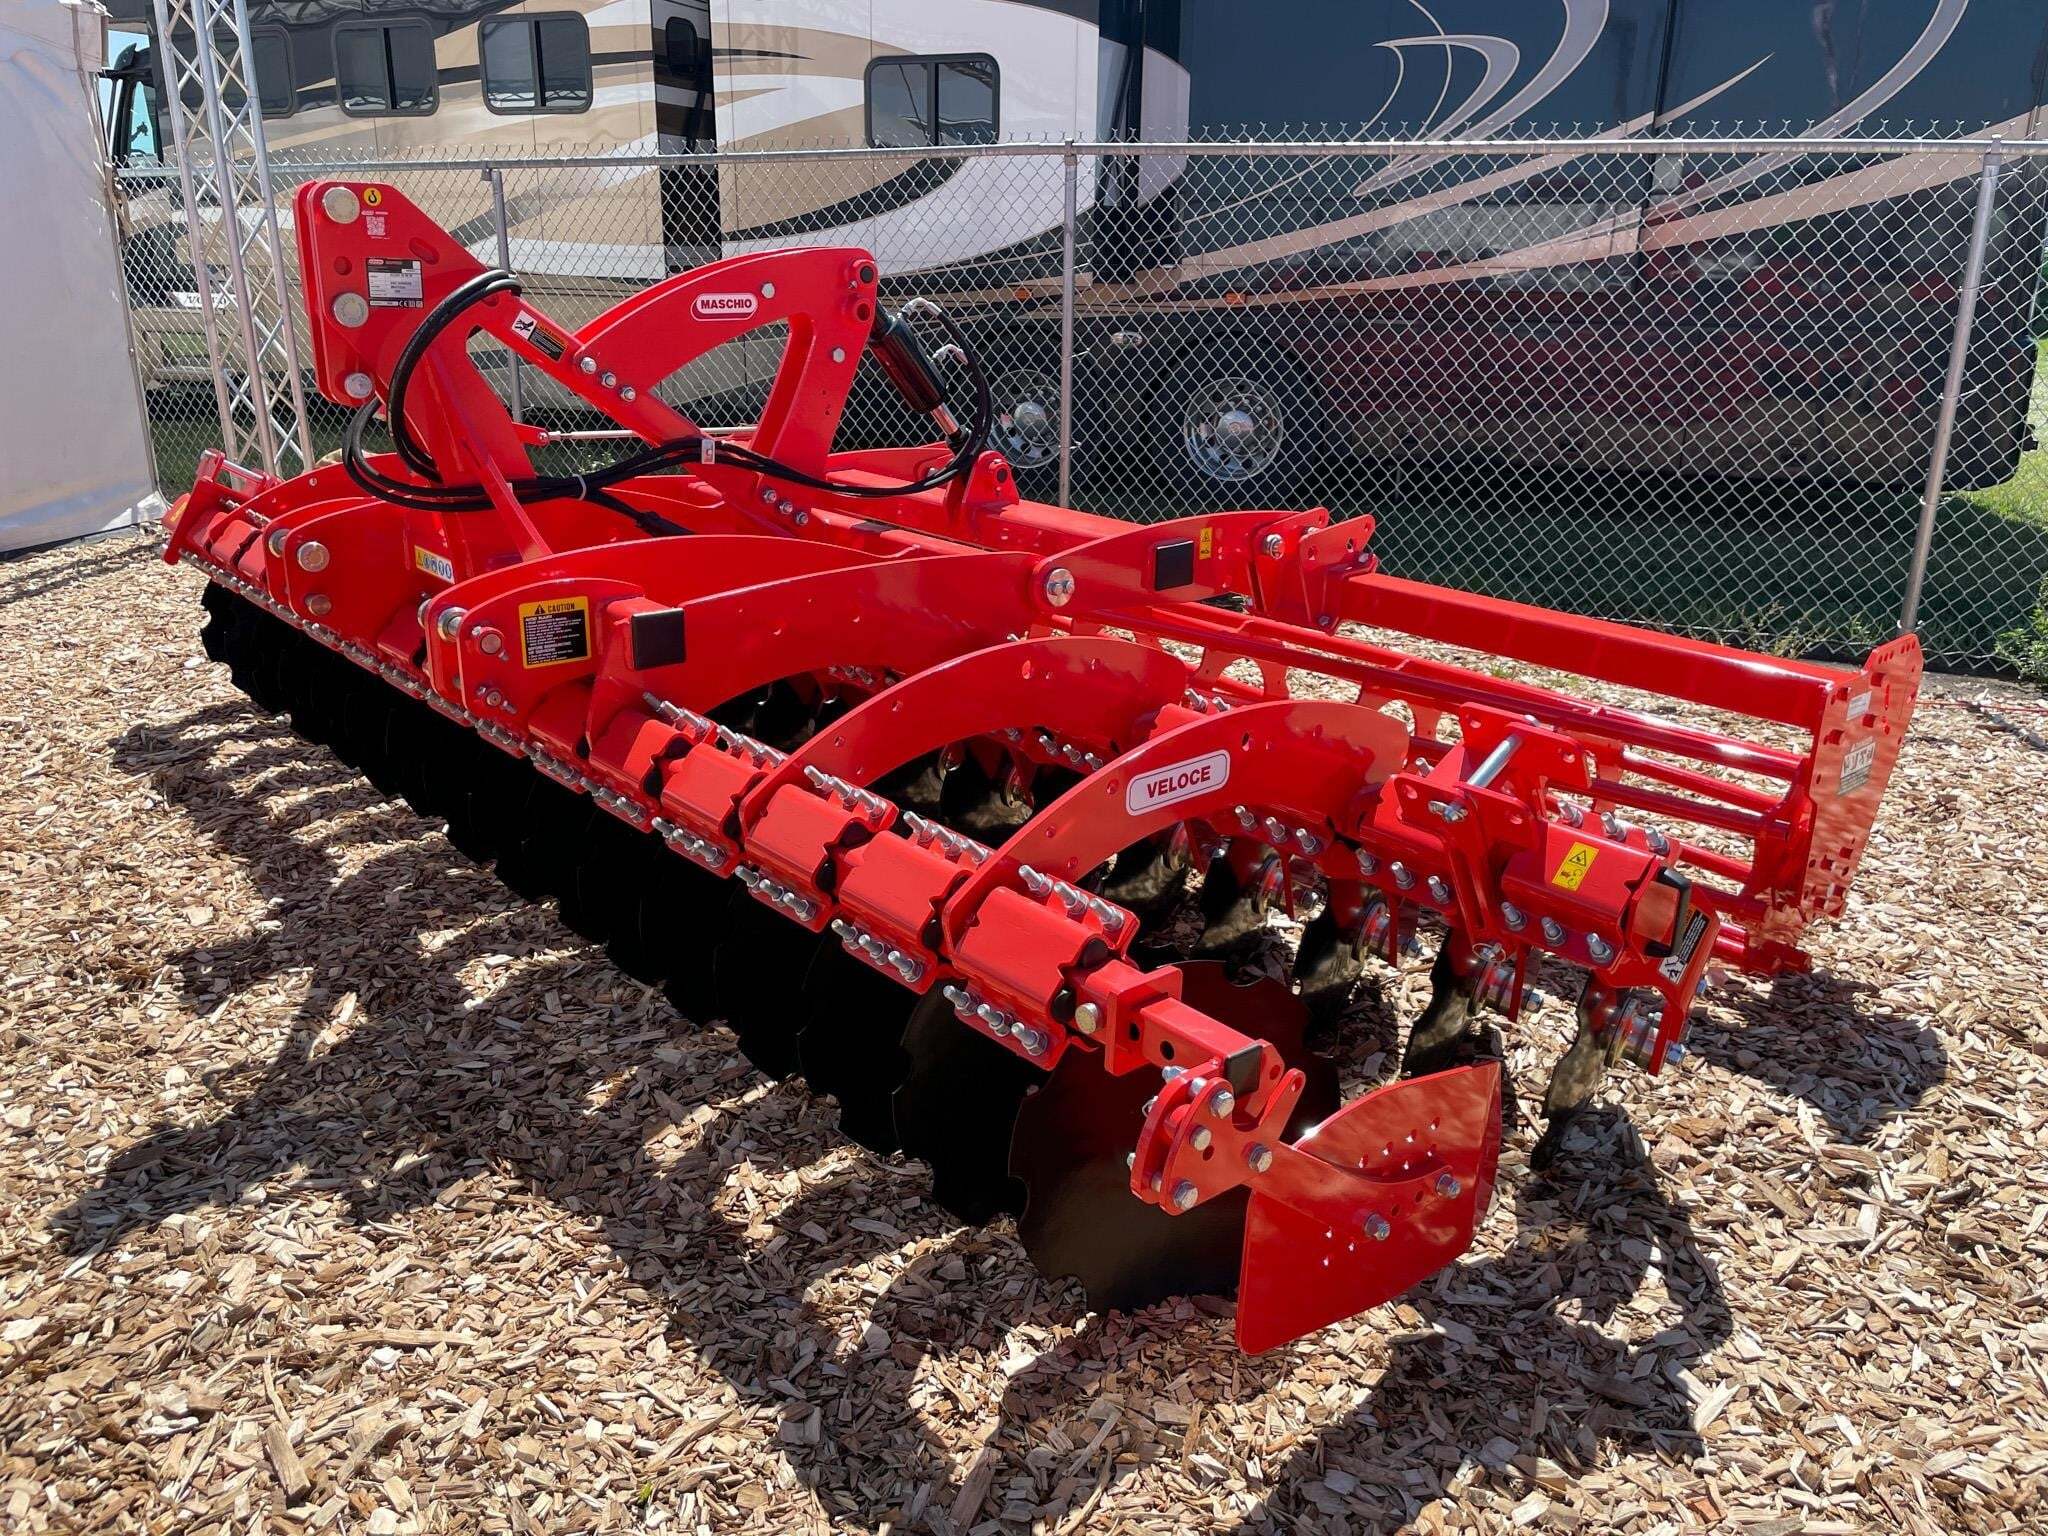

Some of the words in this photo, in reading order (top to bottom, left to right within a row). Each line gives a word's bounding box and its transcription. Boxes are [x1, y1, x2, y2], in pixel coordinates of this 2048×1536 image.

[700, 299, 752, 309] MASCHIO
[548, 602, 575, 613] CAUTION
[1147, 765, 1211, 799] VELOCE
